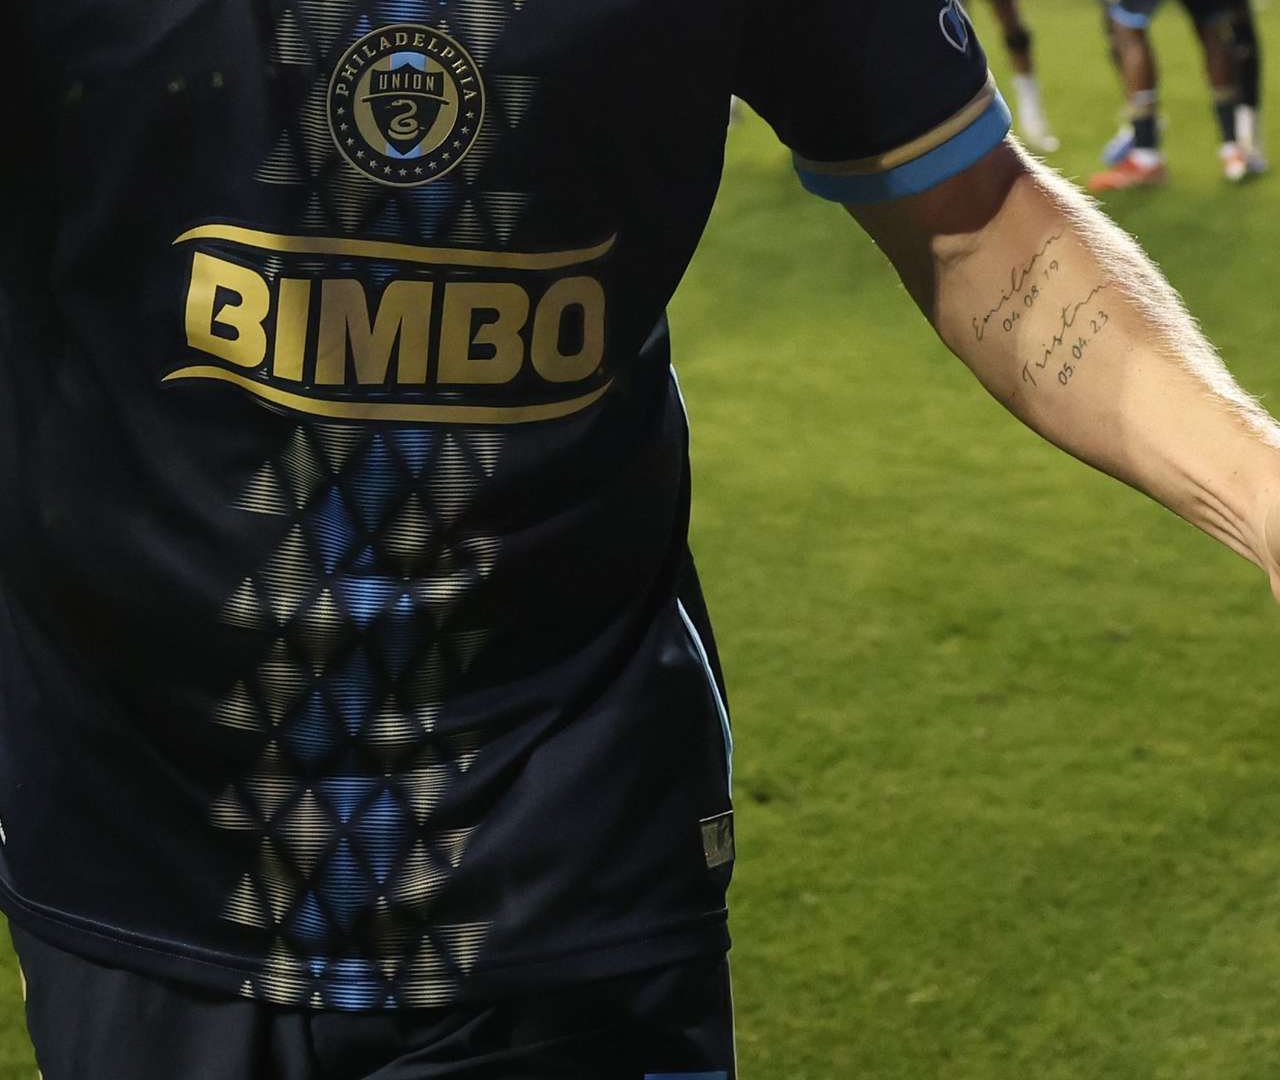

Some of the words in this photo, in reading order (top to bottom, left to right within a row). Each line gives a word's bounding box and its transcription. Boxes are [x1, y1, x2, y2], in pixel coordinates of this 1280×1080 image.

[336, 32, 478, 102] PHILADELPHIA
[379, 74, 434, 92] UNION
[185, 251, 606, 385] BIMBO
